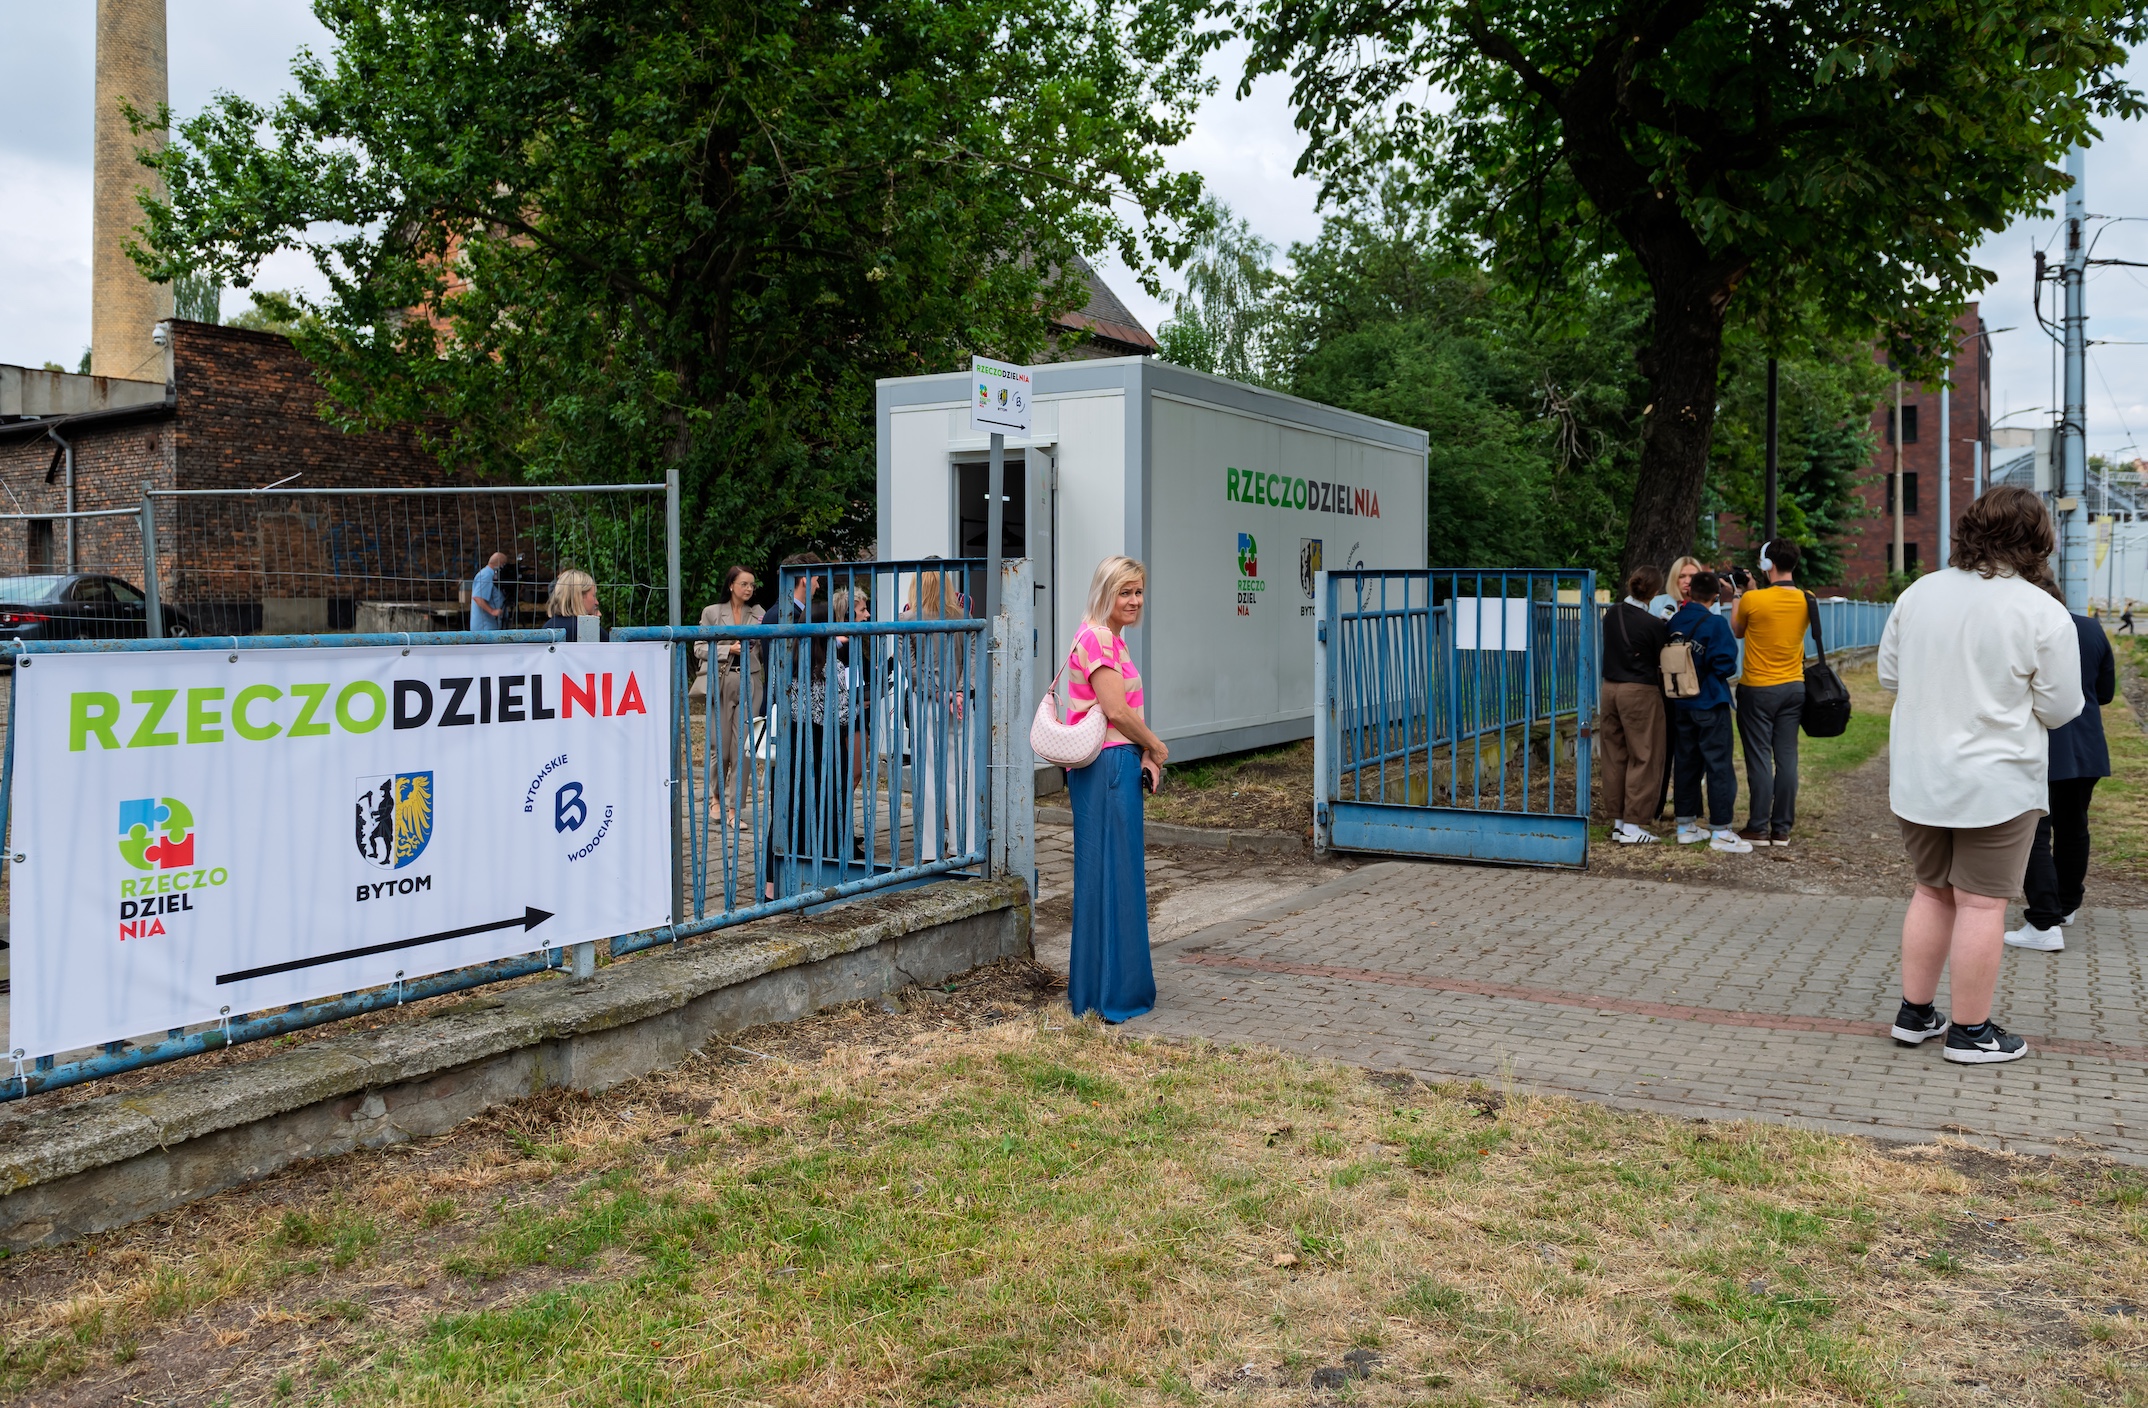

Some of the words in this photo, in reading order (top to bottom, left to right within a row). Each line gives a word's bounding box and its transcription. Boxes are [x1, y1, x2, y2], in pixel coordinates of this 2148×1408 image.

[976, 364, 1030, 383] RZECZODZIELNIA
[1227, 467, 1380, 519] RZECZODZIELNIA
[1237, 579, 1266, 592] RZECZO
[1237, 592, 1257, 604] DZIEL
[1237, 605, 1250, 616] NIA
[68, 670, 647, 752] RZECZODZIELNIA
[524, 754, 568, 813] BYTOMSKIE
[567, 805, 613, 862] WODOCIĄGI
[121, 867, 228, 899] RZECZO
[356, 874, 432, 902] BYTOM
[120, 893, 193, 920] DZIEL
[119, 917, 166, 941] NIA
